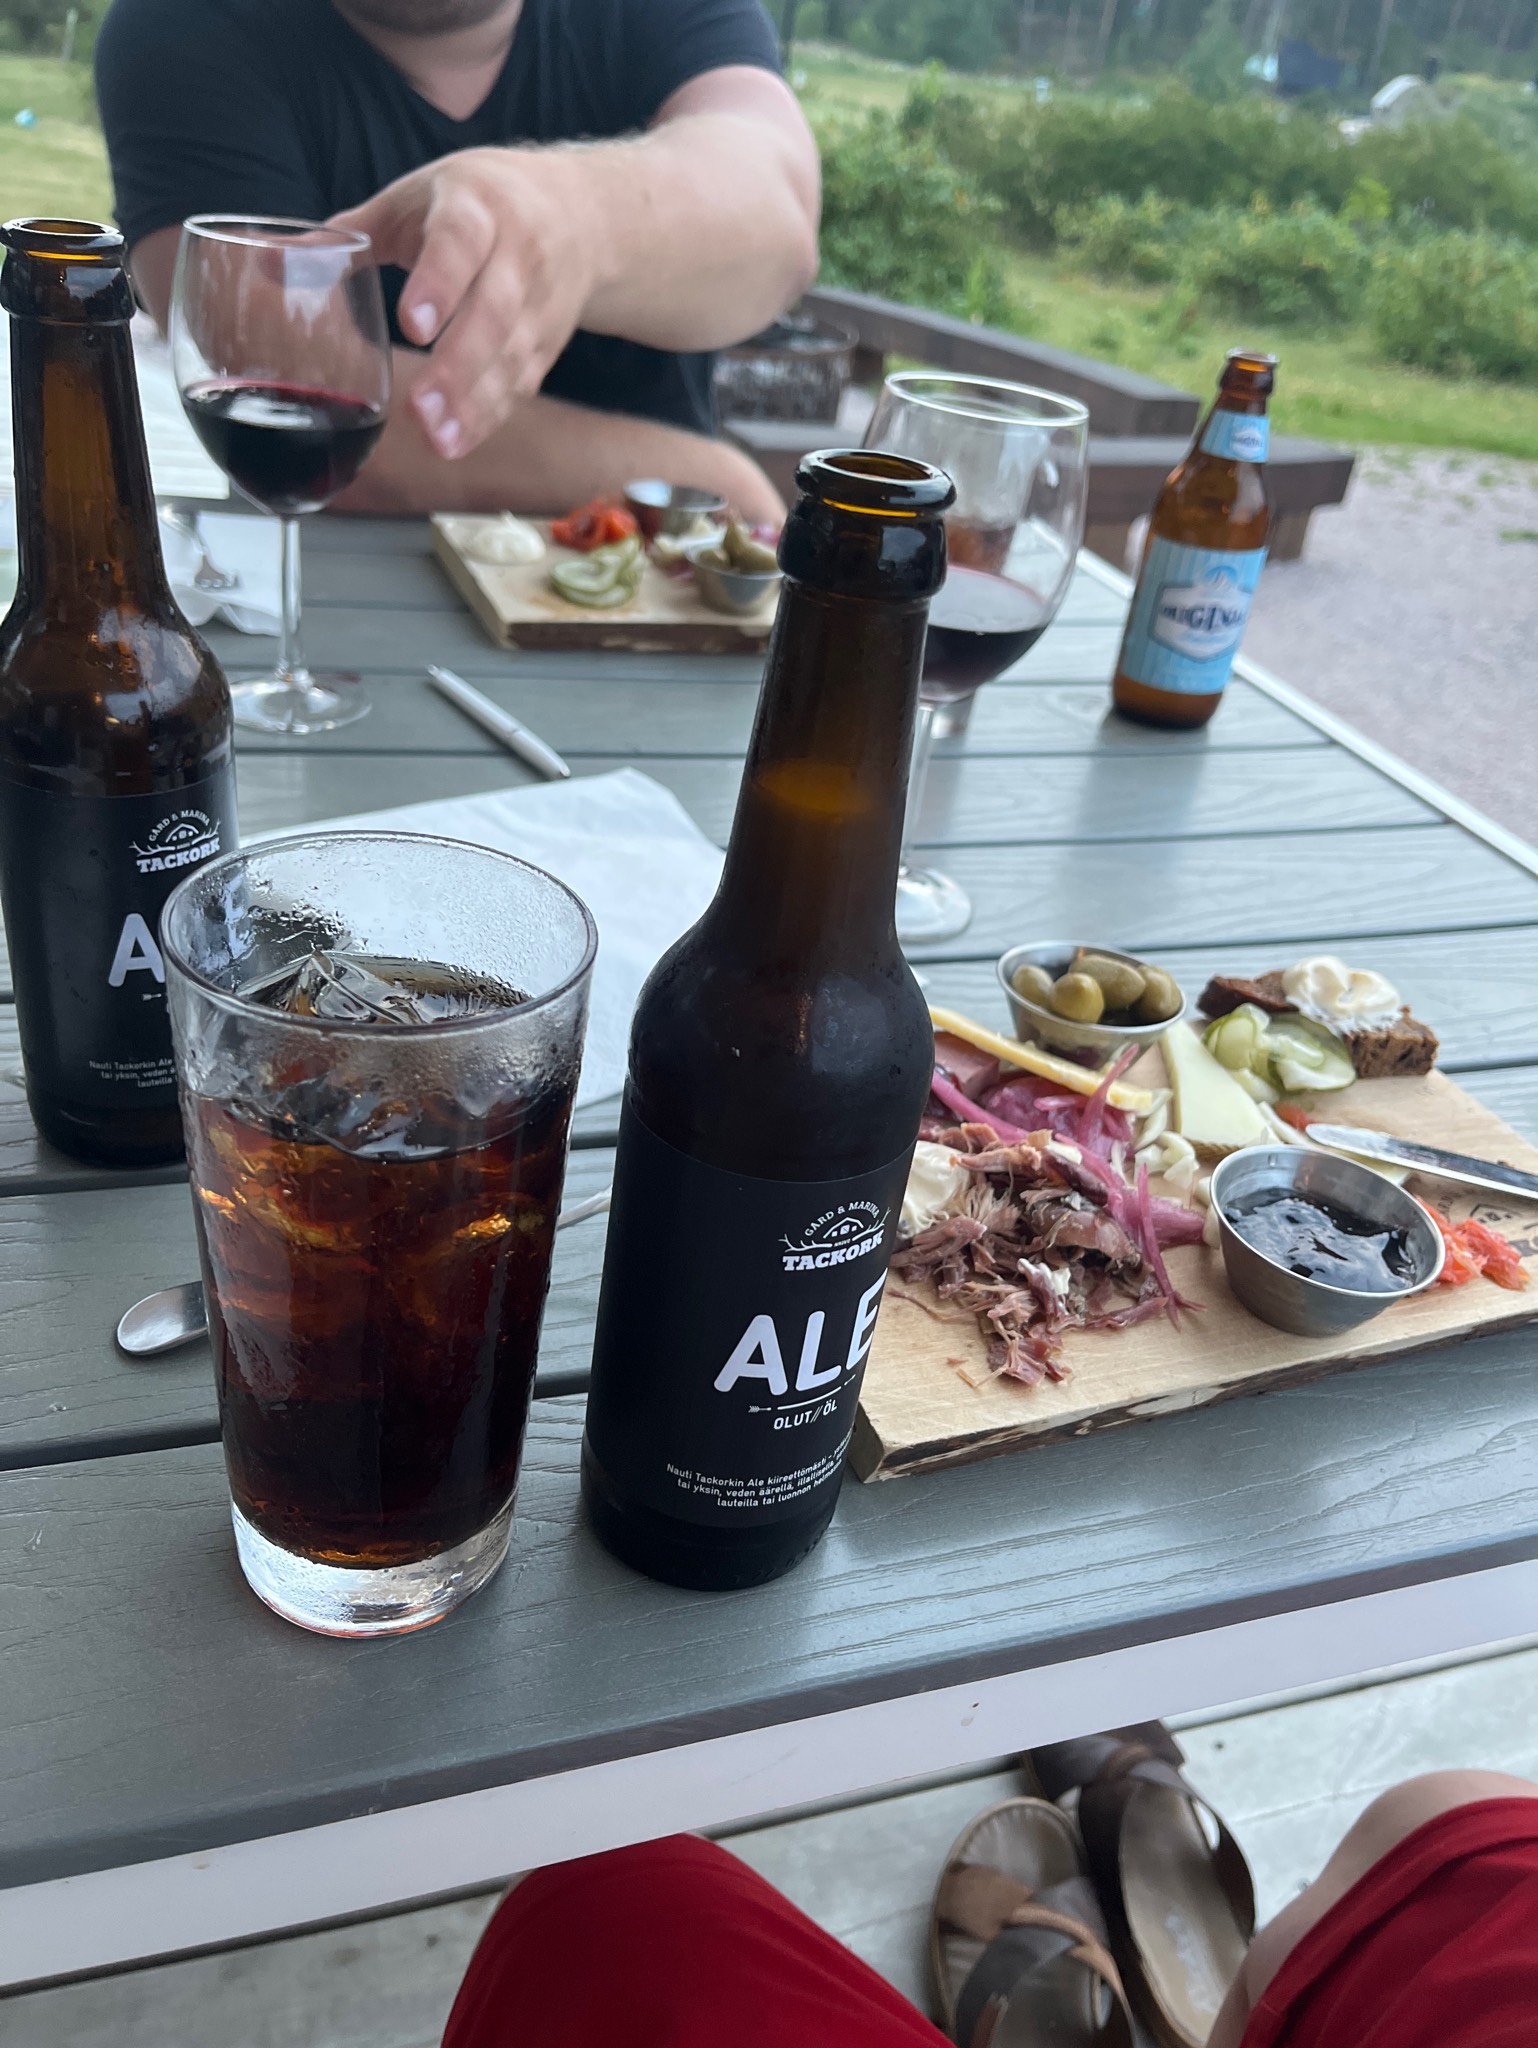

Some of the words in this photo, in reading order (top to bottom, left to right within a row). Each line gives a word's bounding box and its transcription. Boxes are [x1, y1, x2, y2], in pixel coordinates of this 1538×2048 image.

[149, 818, 170, 842] GARD
[181, 809, 210, 826] MARINA
[136, 837, 220, 873] TACKORK
[89, 1060, 112, 1070] Nauti
[804, 1211, 835, 1236] GARD
[837, 1205, 846, 1214] &
[848, 1201, 880, 1219] MARINA
[782, 1229, 885, 1271] TACKORK
[713, 1267, 888, 1396] ALE
[666, 1463, 693, 1479] Nauti
[695, 1472, 744, 1487] Tackorkin
[747, 1478, 765, 1487] Ale
[767, 1456, 827, 1485] kiireettömästi
[677, 1478, 691, 1489] tai
[692, 1485, 722, 1497] yksin,
[726, 1488, 756, 1497] veden
[758, 1482, 795, 1496] äärellä,
[717, 1498, 759, 1507] lauteilla
[762, 1495, 776, 1505] tai
[778, 1484, 812, 1502] luonnon
